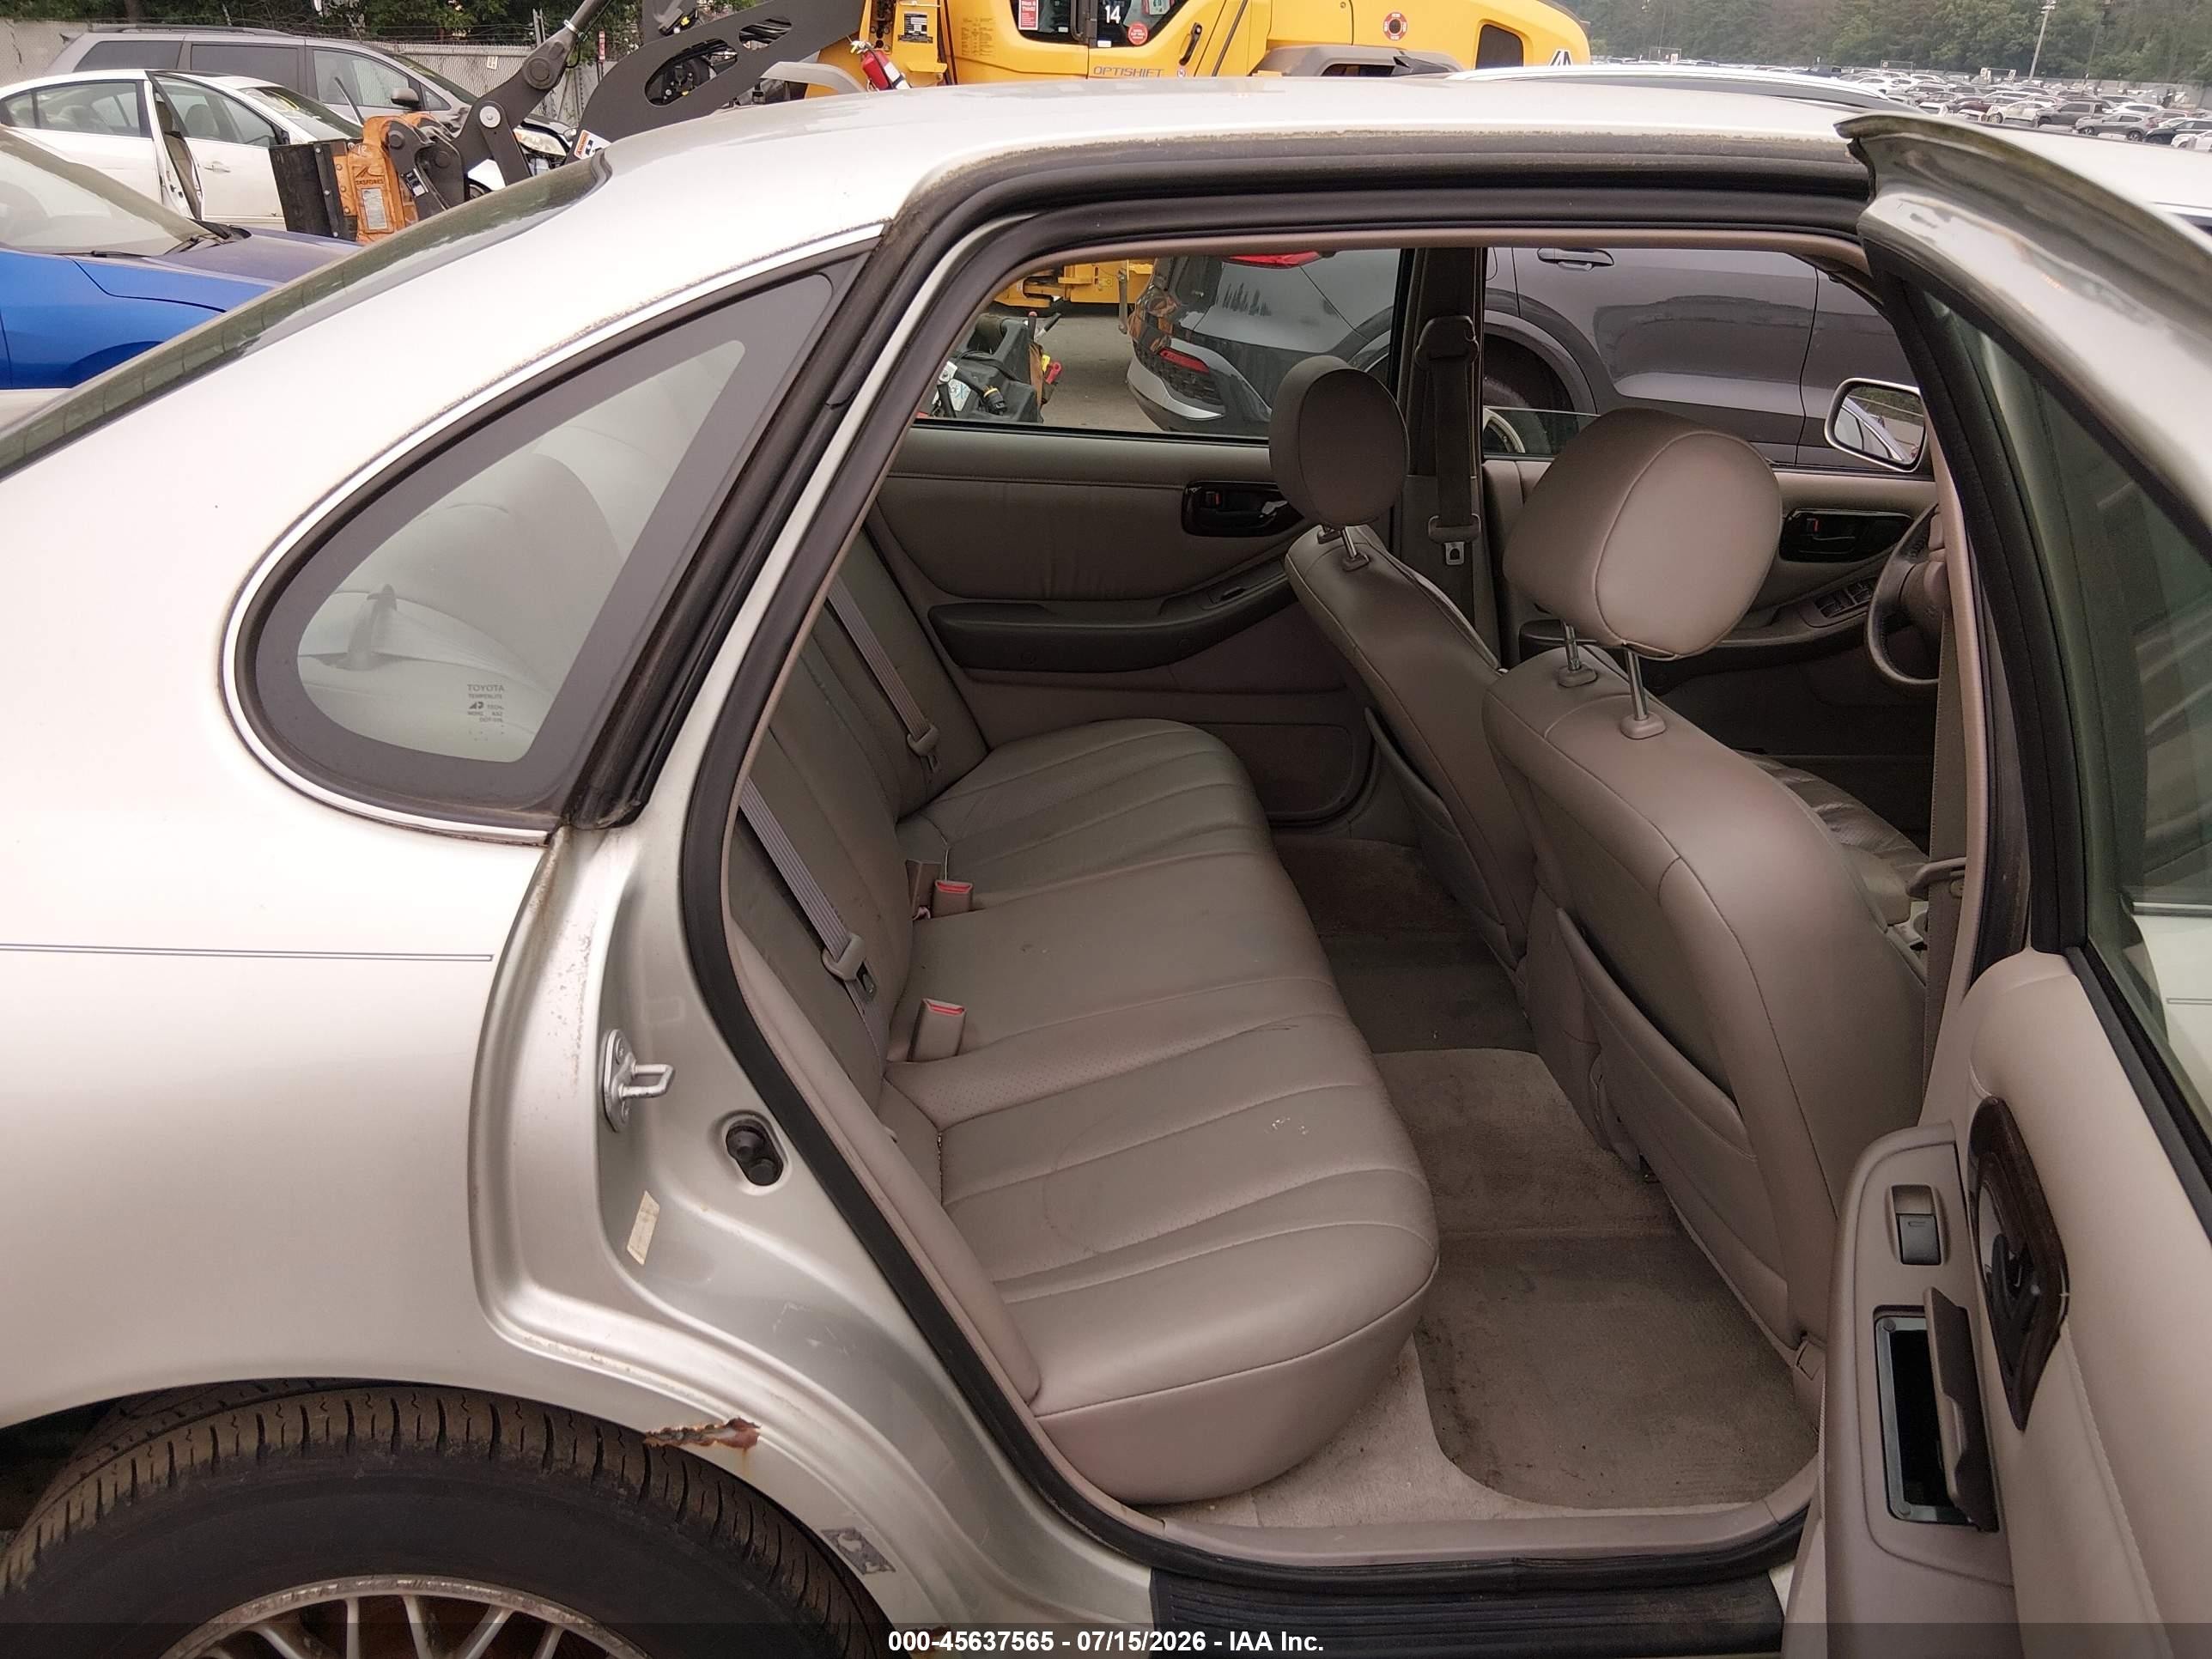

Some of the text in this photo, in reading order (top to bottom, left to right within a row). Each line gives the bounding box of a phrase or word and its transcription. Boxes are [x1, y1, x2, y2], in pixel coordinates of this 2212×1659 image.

[1104, 5, 1121, 24] 14
[1093, 65, 1164, 77] OPTISHIFT
[466, 684, 505, 692] TOYOTA
